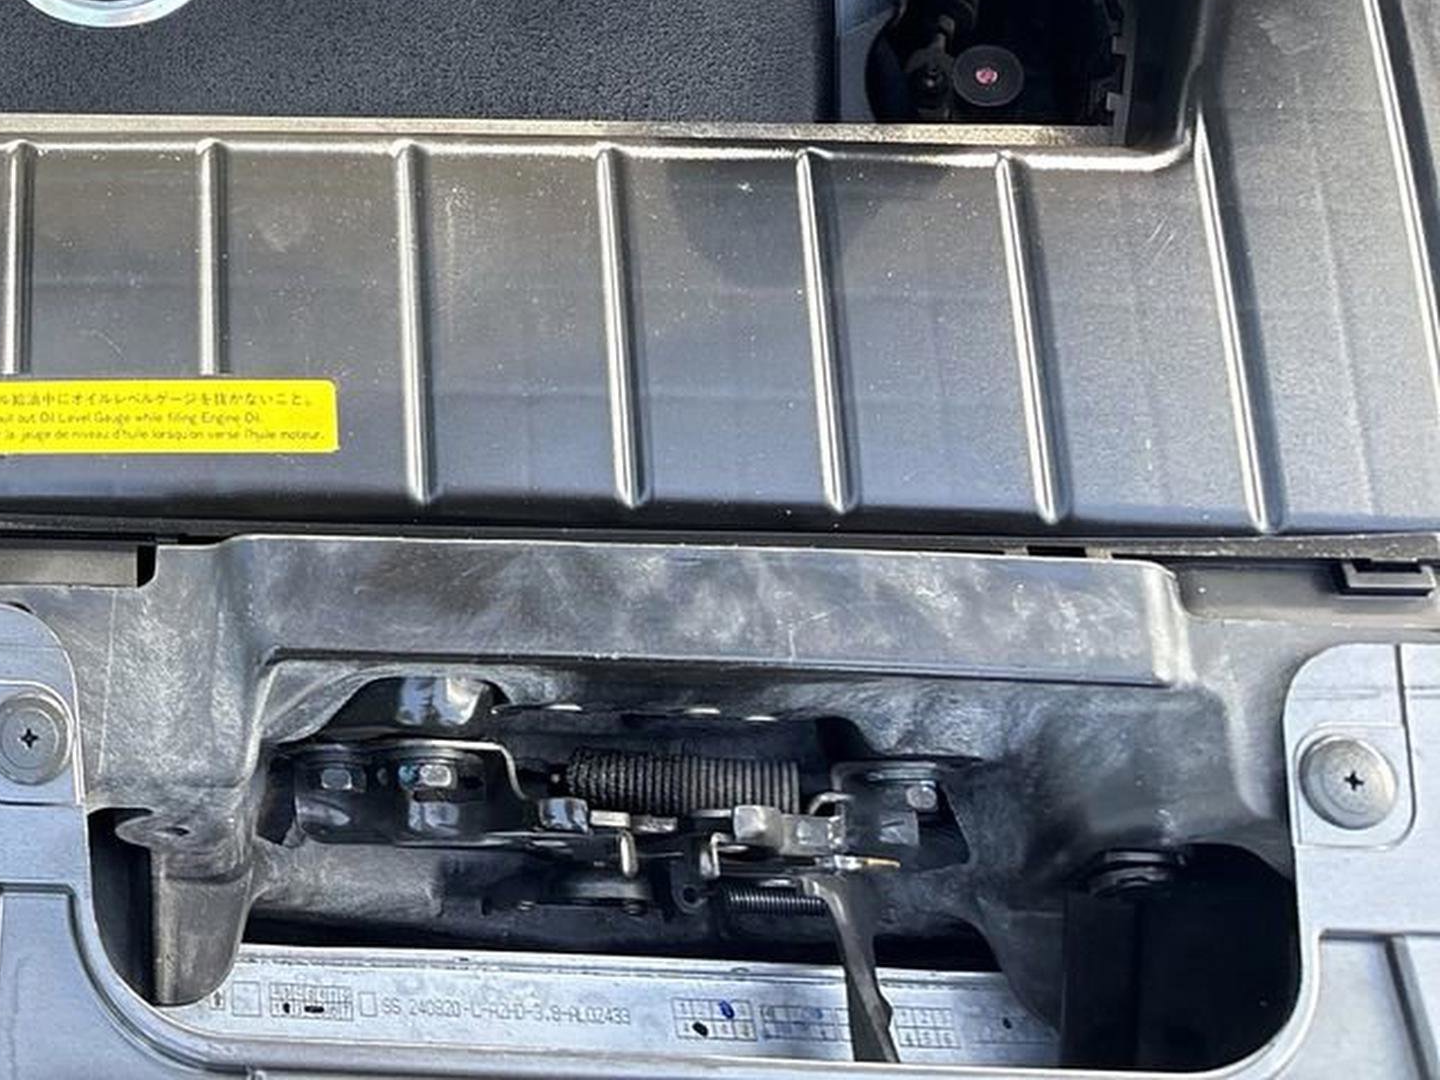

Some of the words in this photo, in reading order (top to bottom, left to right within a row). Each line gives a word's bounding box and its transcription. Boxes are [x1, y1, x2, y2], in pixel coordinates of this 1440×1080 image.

[17, 414, 35, 424] out
[40, 412, 55, 423] Oil
[59, 412, 90, 423] Level
[94, 413, 130, 426] Gauge
[136, 413, 163, 423] while
[201, 412, 240, 425] Engine
[54, 430, 69, 440] de
[72, 430, 108, 440] niveau
[280, 430, 325, 440] moteur.
